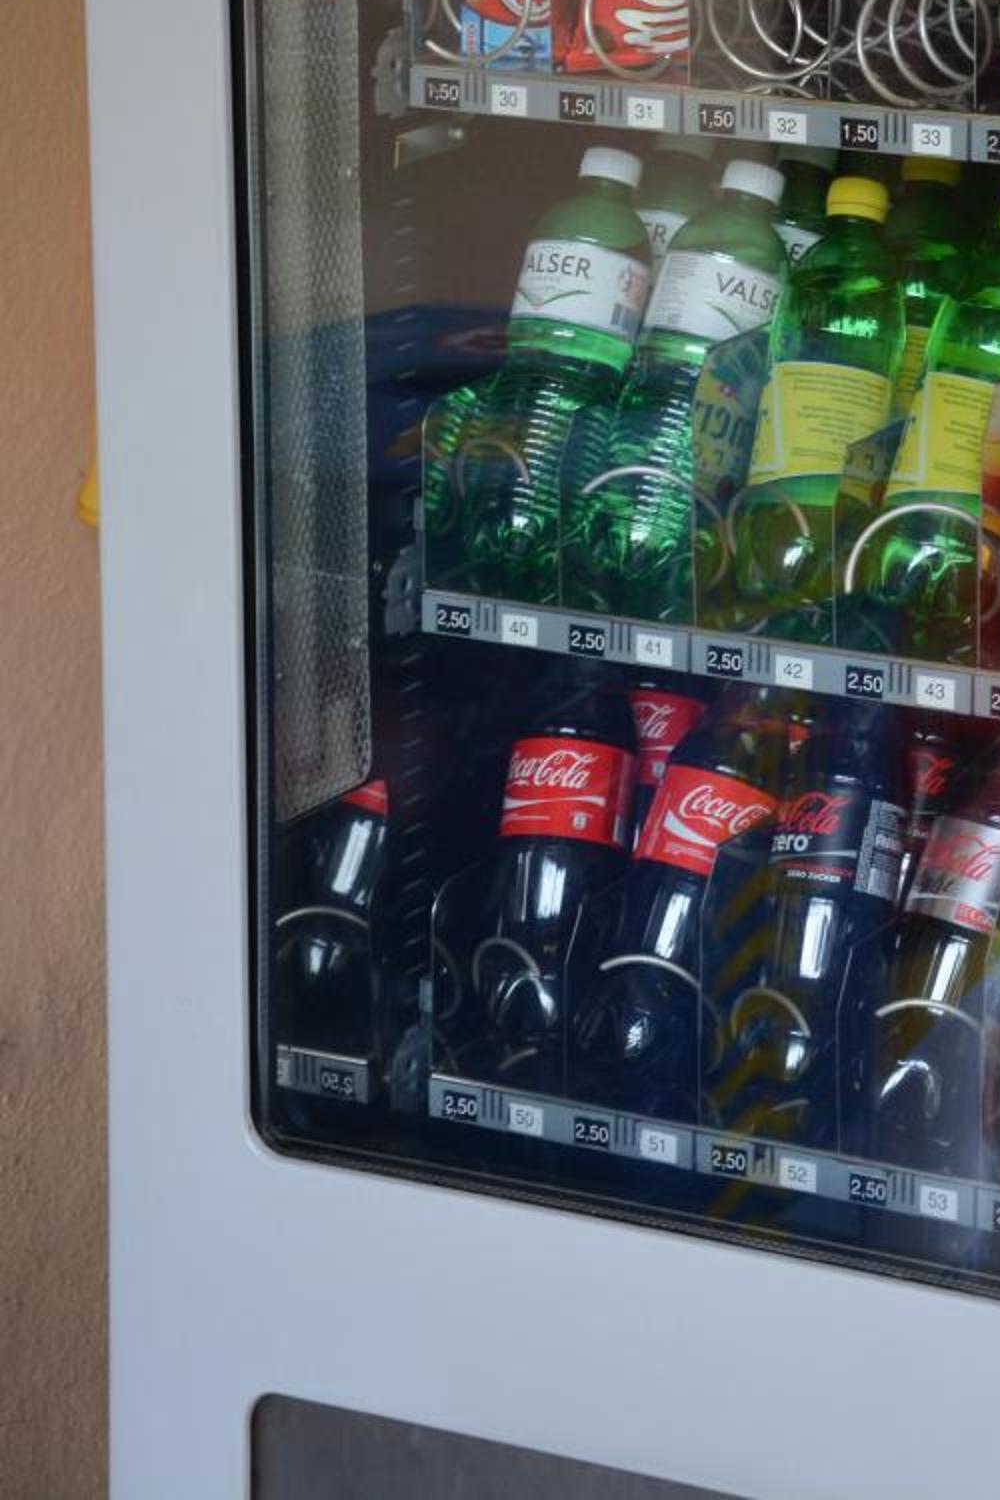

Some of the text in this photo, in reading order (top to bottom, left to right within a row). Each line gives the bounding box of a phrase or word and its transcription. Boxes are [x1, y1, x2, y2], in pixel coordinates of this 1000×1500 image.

[499, 90, 518, 107] 30
[562, 98, 595, 117] 1,50
[701, 110, 734, 128] 1,50
[777, 118, 798, 135] 32
[844, 123, 878, 144] 1,50
[920, 128, 941, 147] 33
[527, 253, 591, 278] ALSER
[716, 272, 778, 315] VALS
[437, 609, 470, 630] 2,50
[509, 621, 528, 638] 40
[571, 630, 604, 651] 2,50
[645, 639, 663, 656] 41
[707, 651, 741, 671] 2,50
[783, 661, 804, 679] 42
[848, 672, 883, 693] 2,50
[924, 683, 945, 701] 43
[508, 749, 600, 789] oca-Cola
